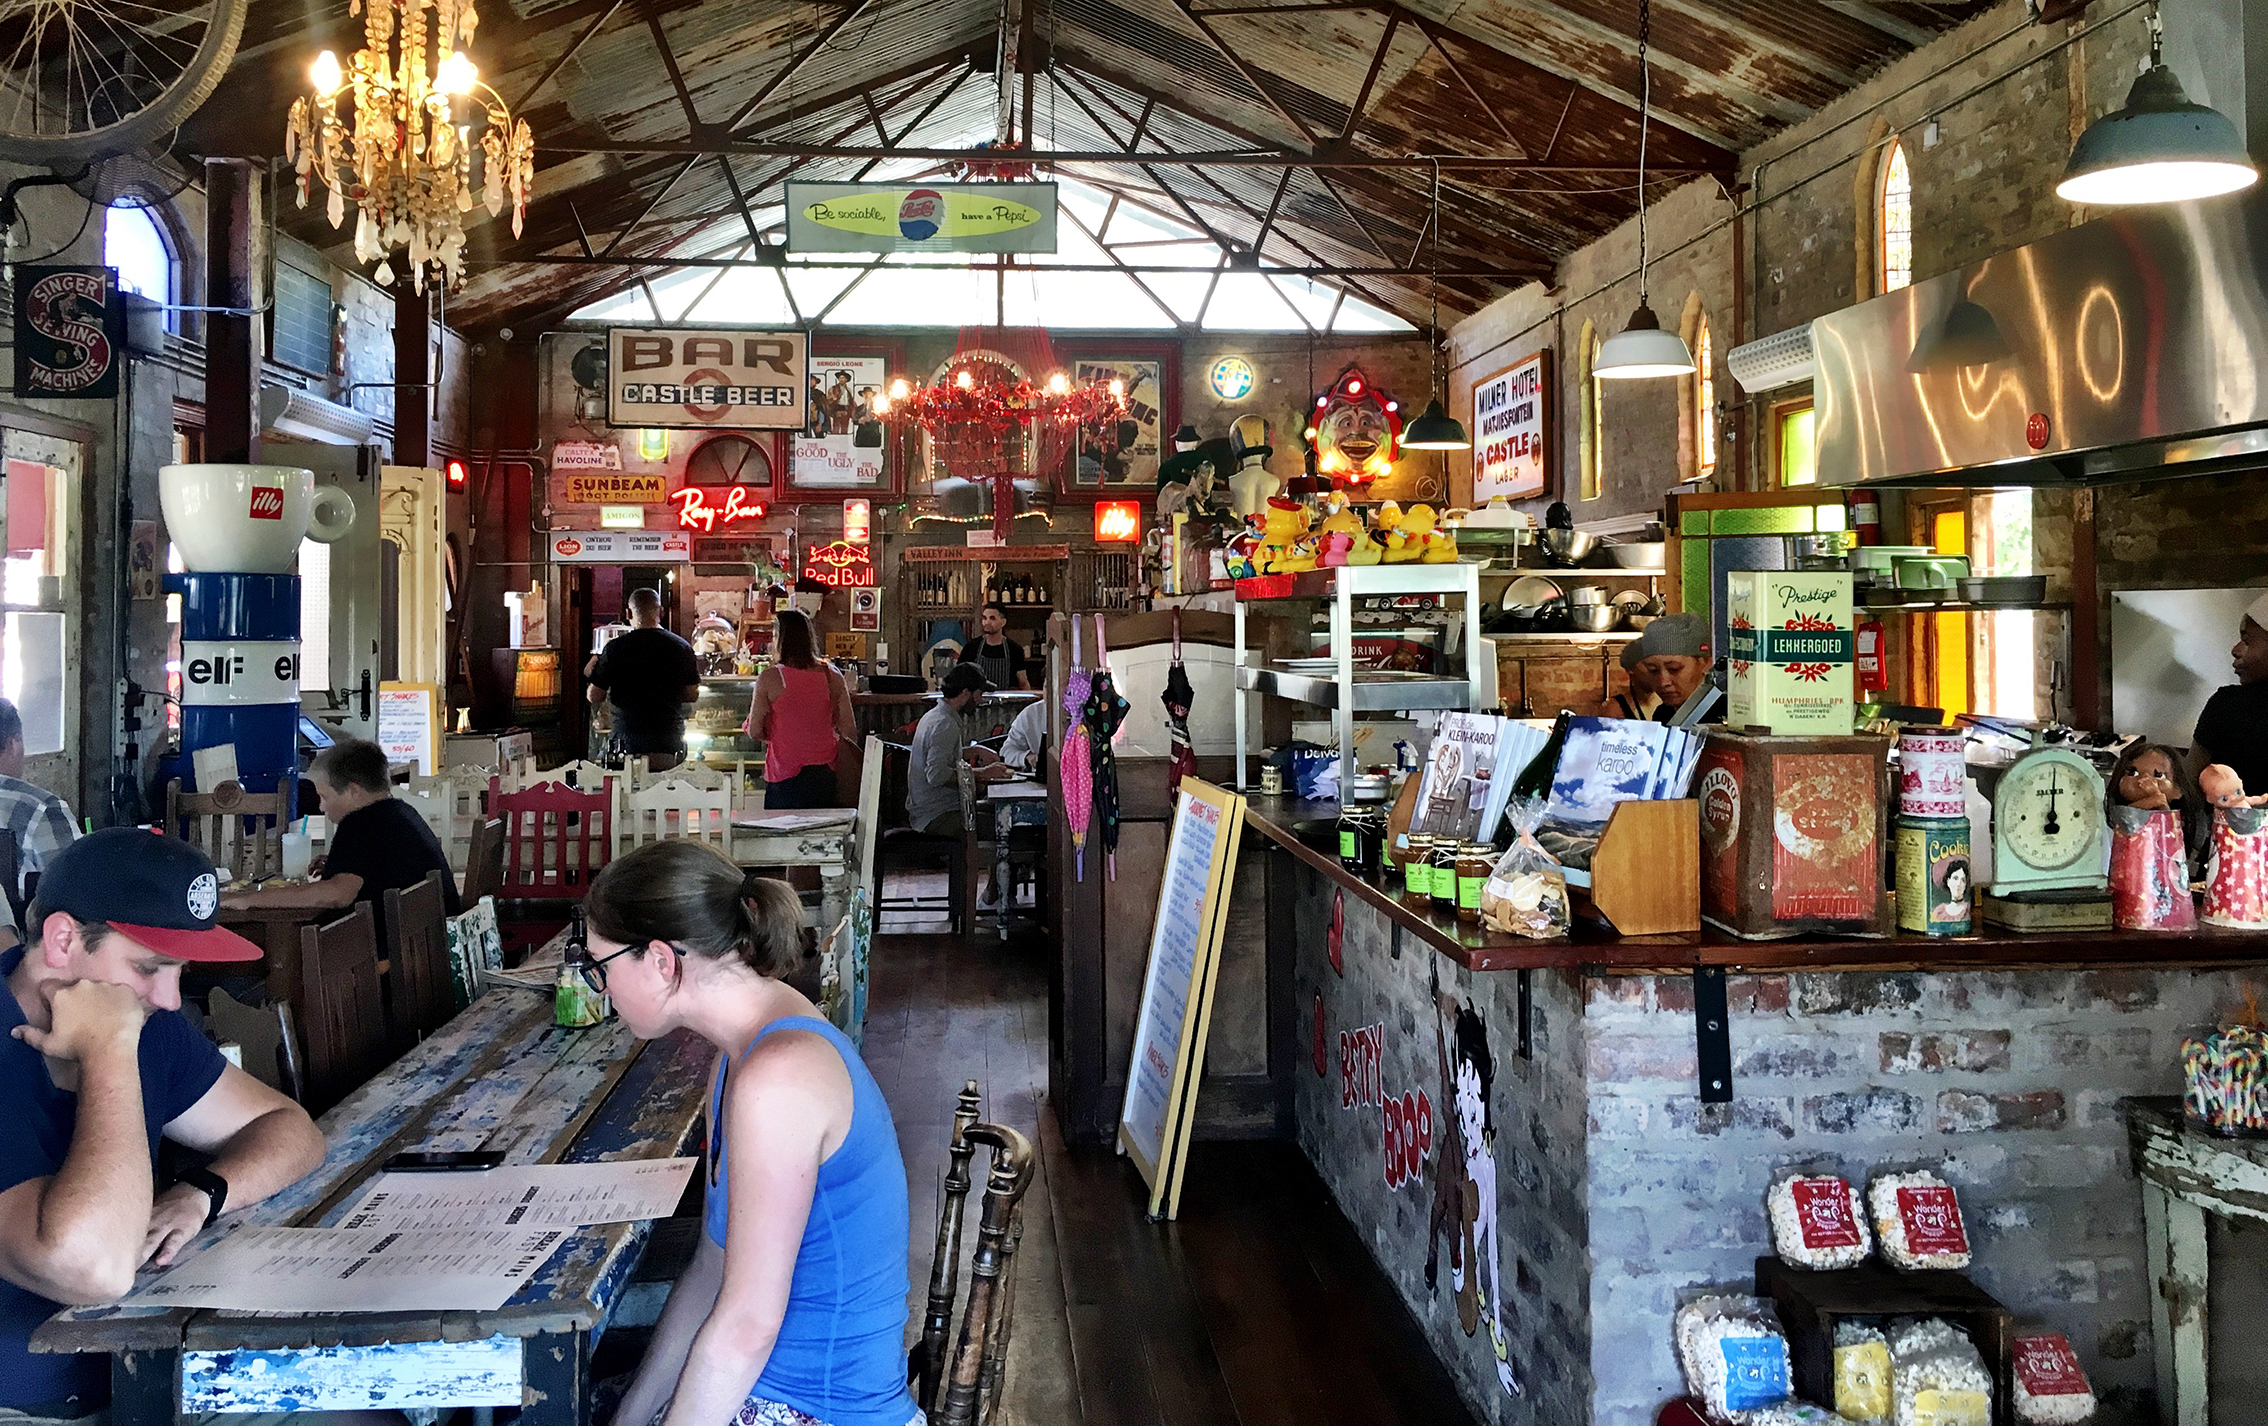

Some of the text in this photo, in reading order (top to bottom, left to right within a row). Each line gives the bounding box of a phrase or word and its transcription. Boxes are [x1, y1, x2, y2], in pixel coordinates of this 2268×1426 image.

[808, 203, 886, 222] Be sociable,
[961, 212, 984, 221] have
[992, 205, 1031, 224] Pepsi
[34, 276, 99, 304] SINGER
[622, 335, 795, 377] BAR
[29, 358, 104, 388] MACHINES
[624, 384, 792, 406] CASTLE BEER
[1478, 365, 1541, 416] MILNER HOTEL
[796, 447, 828, 458] GOOD
[1486, 431, 1529, 466] CASTLE
[557, 456, 603, 465] HAVOLINE
[828, 457, 856, 468] UGLY
[857, 467, 879, 478] BAD
[1494, 466, 1519, 486] LAGER
[572, 478, 660, 491] SUNBEAM
[252, 491, 282, 516] illy
[671, 486, 763, 532] Ray-Ban
[604, 512, 641, 520] AMIGOS
[1100, 508, 1135, 539] illy
[911, 549, 963, 559] VALLEY INN
[804, 567, 875, 586] Red Bull
[1351, 645, 1383, 656] DRINK
[1773, 638, 1842, 654] LEKKERGOED
[188, 656, 244, 685] elf
[1447, 729, 1495, 746] KLEIN-KAROO
[1600, 740, 1638, 756] timeless
[1595, 751, 1634, 776] karoo
[1704, 772, 1737, 800] ILLOVO
[1708, 795, 1732, 811] Golden
[1339, 1021, 1384, 1111] BETTY
[1382, 1085, 1433, 1193] BOOP
[1809, 1197, 1839, 1206] Wonder
[1912, 1203, 1946, 1213] Wonder
